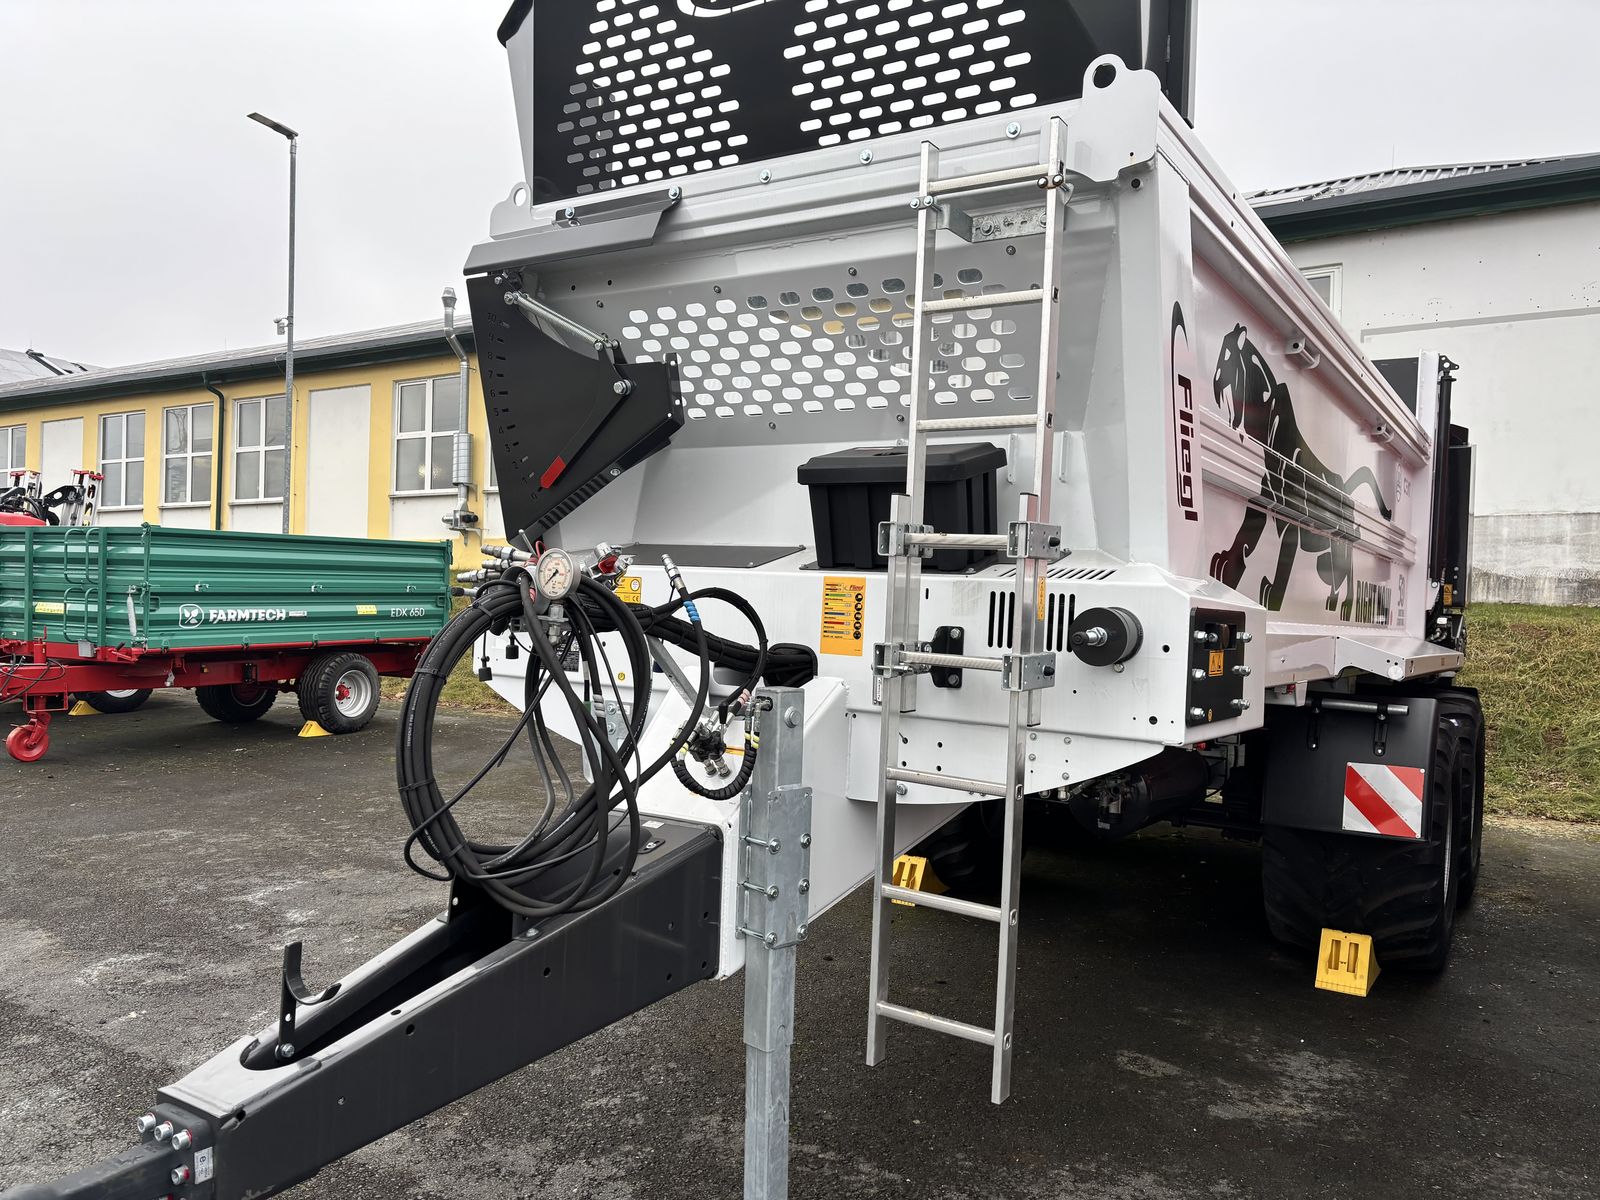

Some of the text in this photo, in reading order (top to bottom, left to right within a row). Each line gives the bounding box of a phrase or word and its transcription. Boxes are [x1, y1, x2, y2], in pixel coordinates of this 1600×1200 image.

[1177, 373, 1199, 522] Fliegl
[208, 608, 287, 625] FARMTECH
[390, 607, 425, 618] EDX 650
